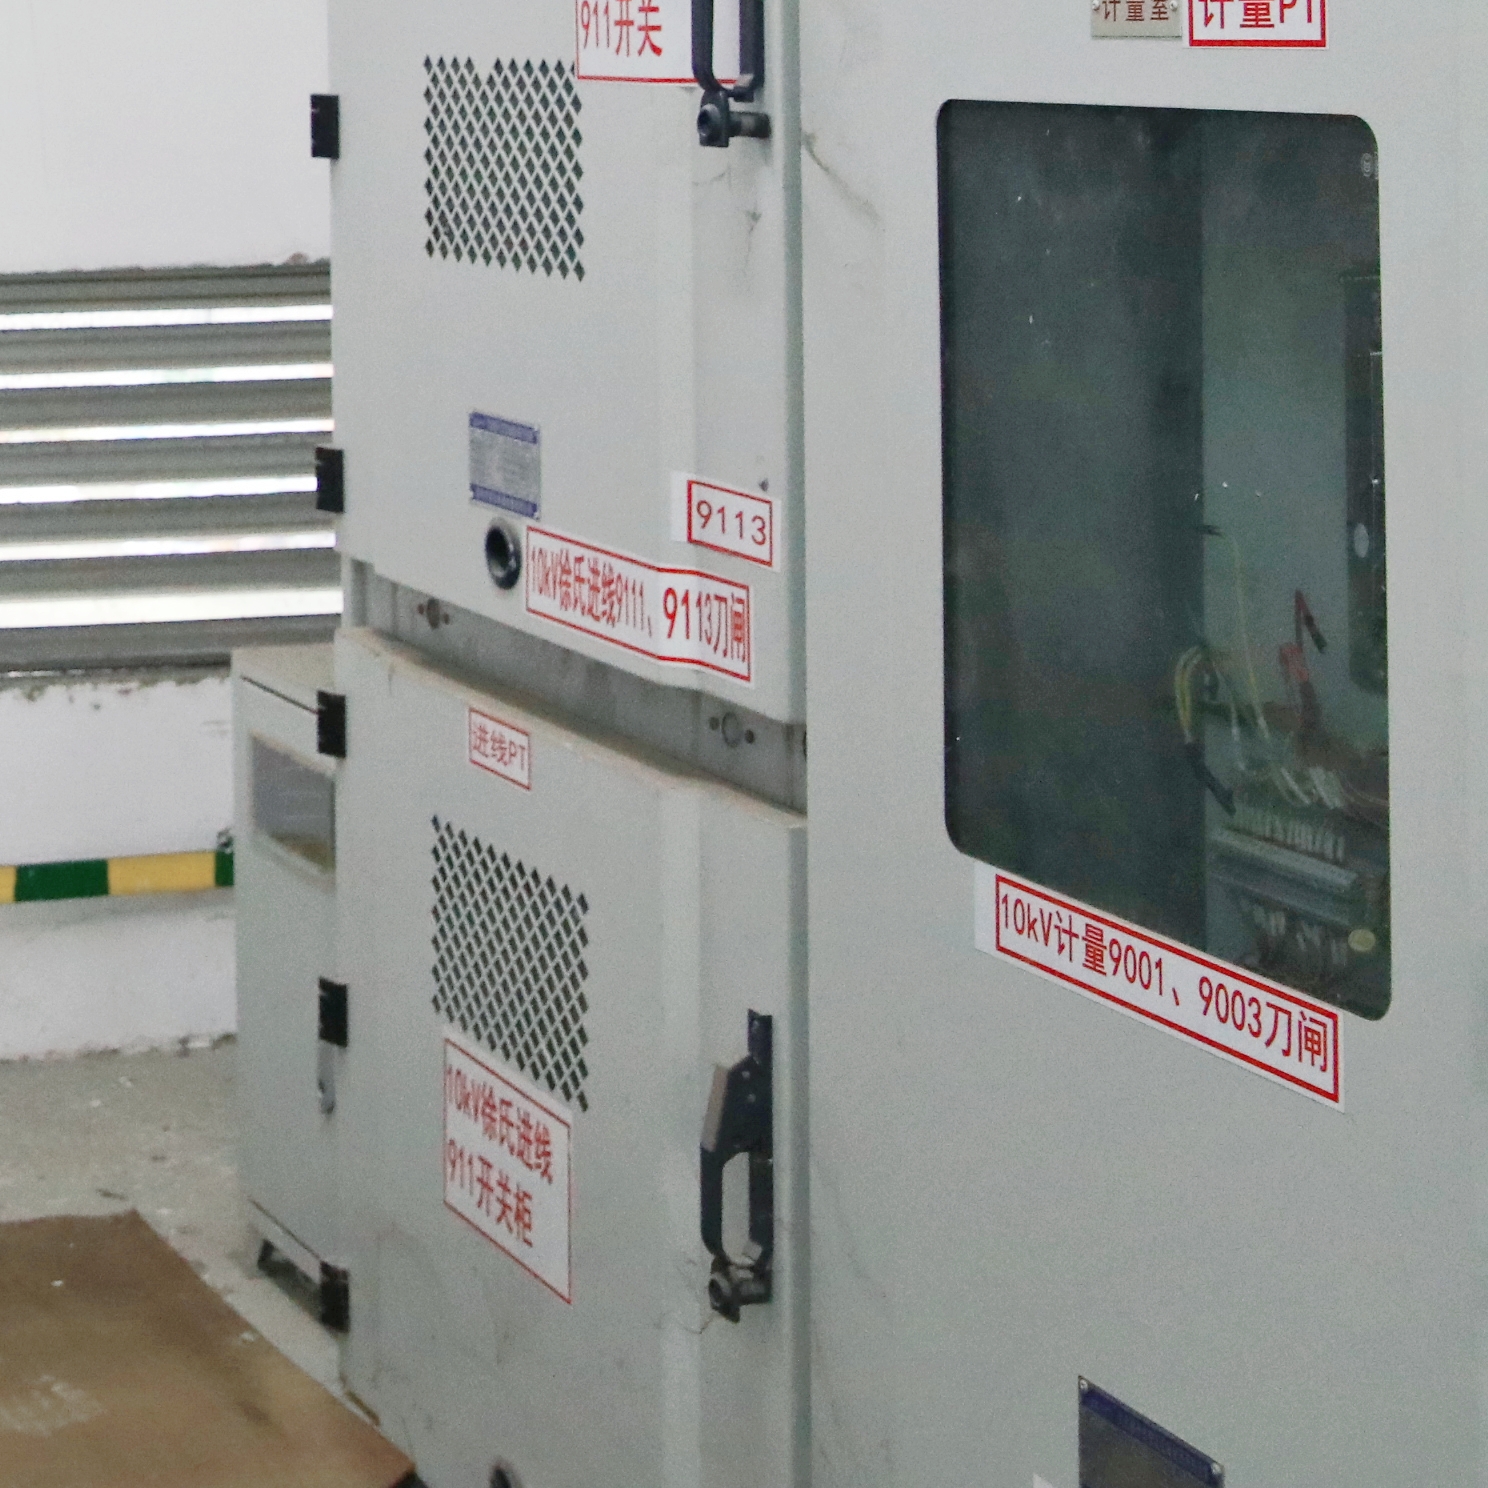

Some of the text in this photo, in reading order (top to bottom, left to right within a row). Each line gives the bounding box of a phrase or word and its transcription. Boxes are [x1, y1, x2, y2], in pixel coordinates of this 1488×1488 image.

[696, 498, 768, 547] 9113
[471, 723, 527, 773] 进线PT
[1000, 891, 1329, 1074] 10kV计量9001、9003刀闸
[445, 1064, 554, 1185] 10kV徐氏进线
[446, 1138, 533, 1248] 911开关柜
